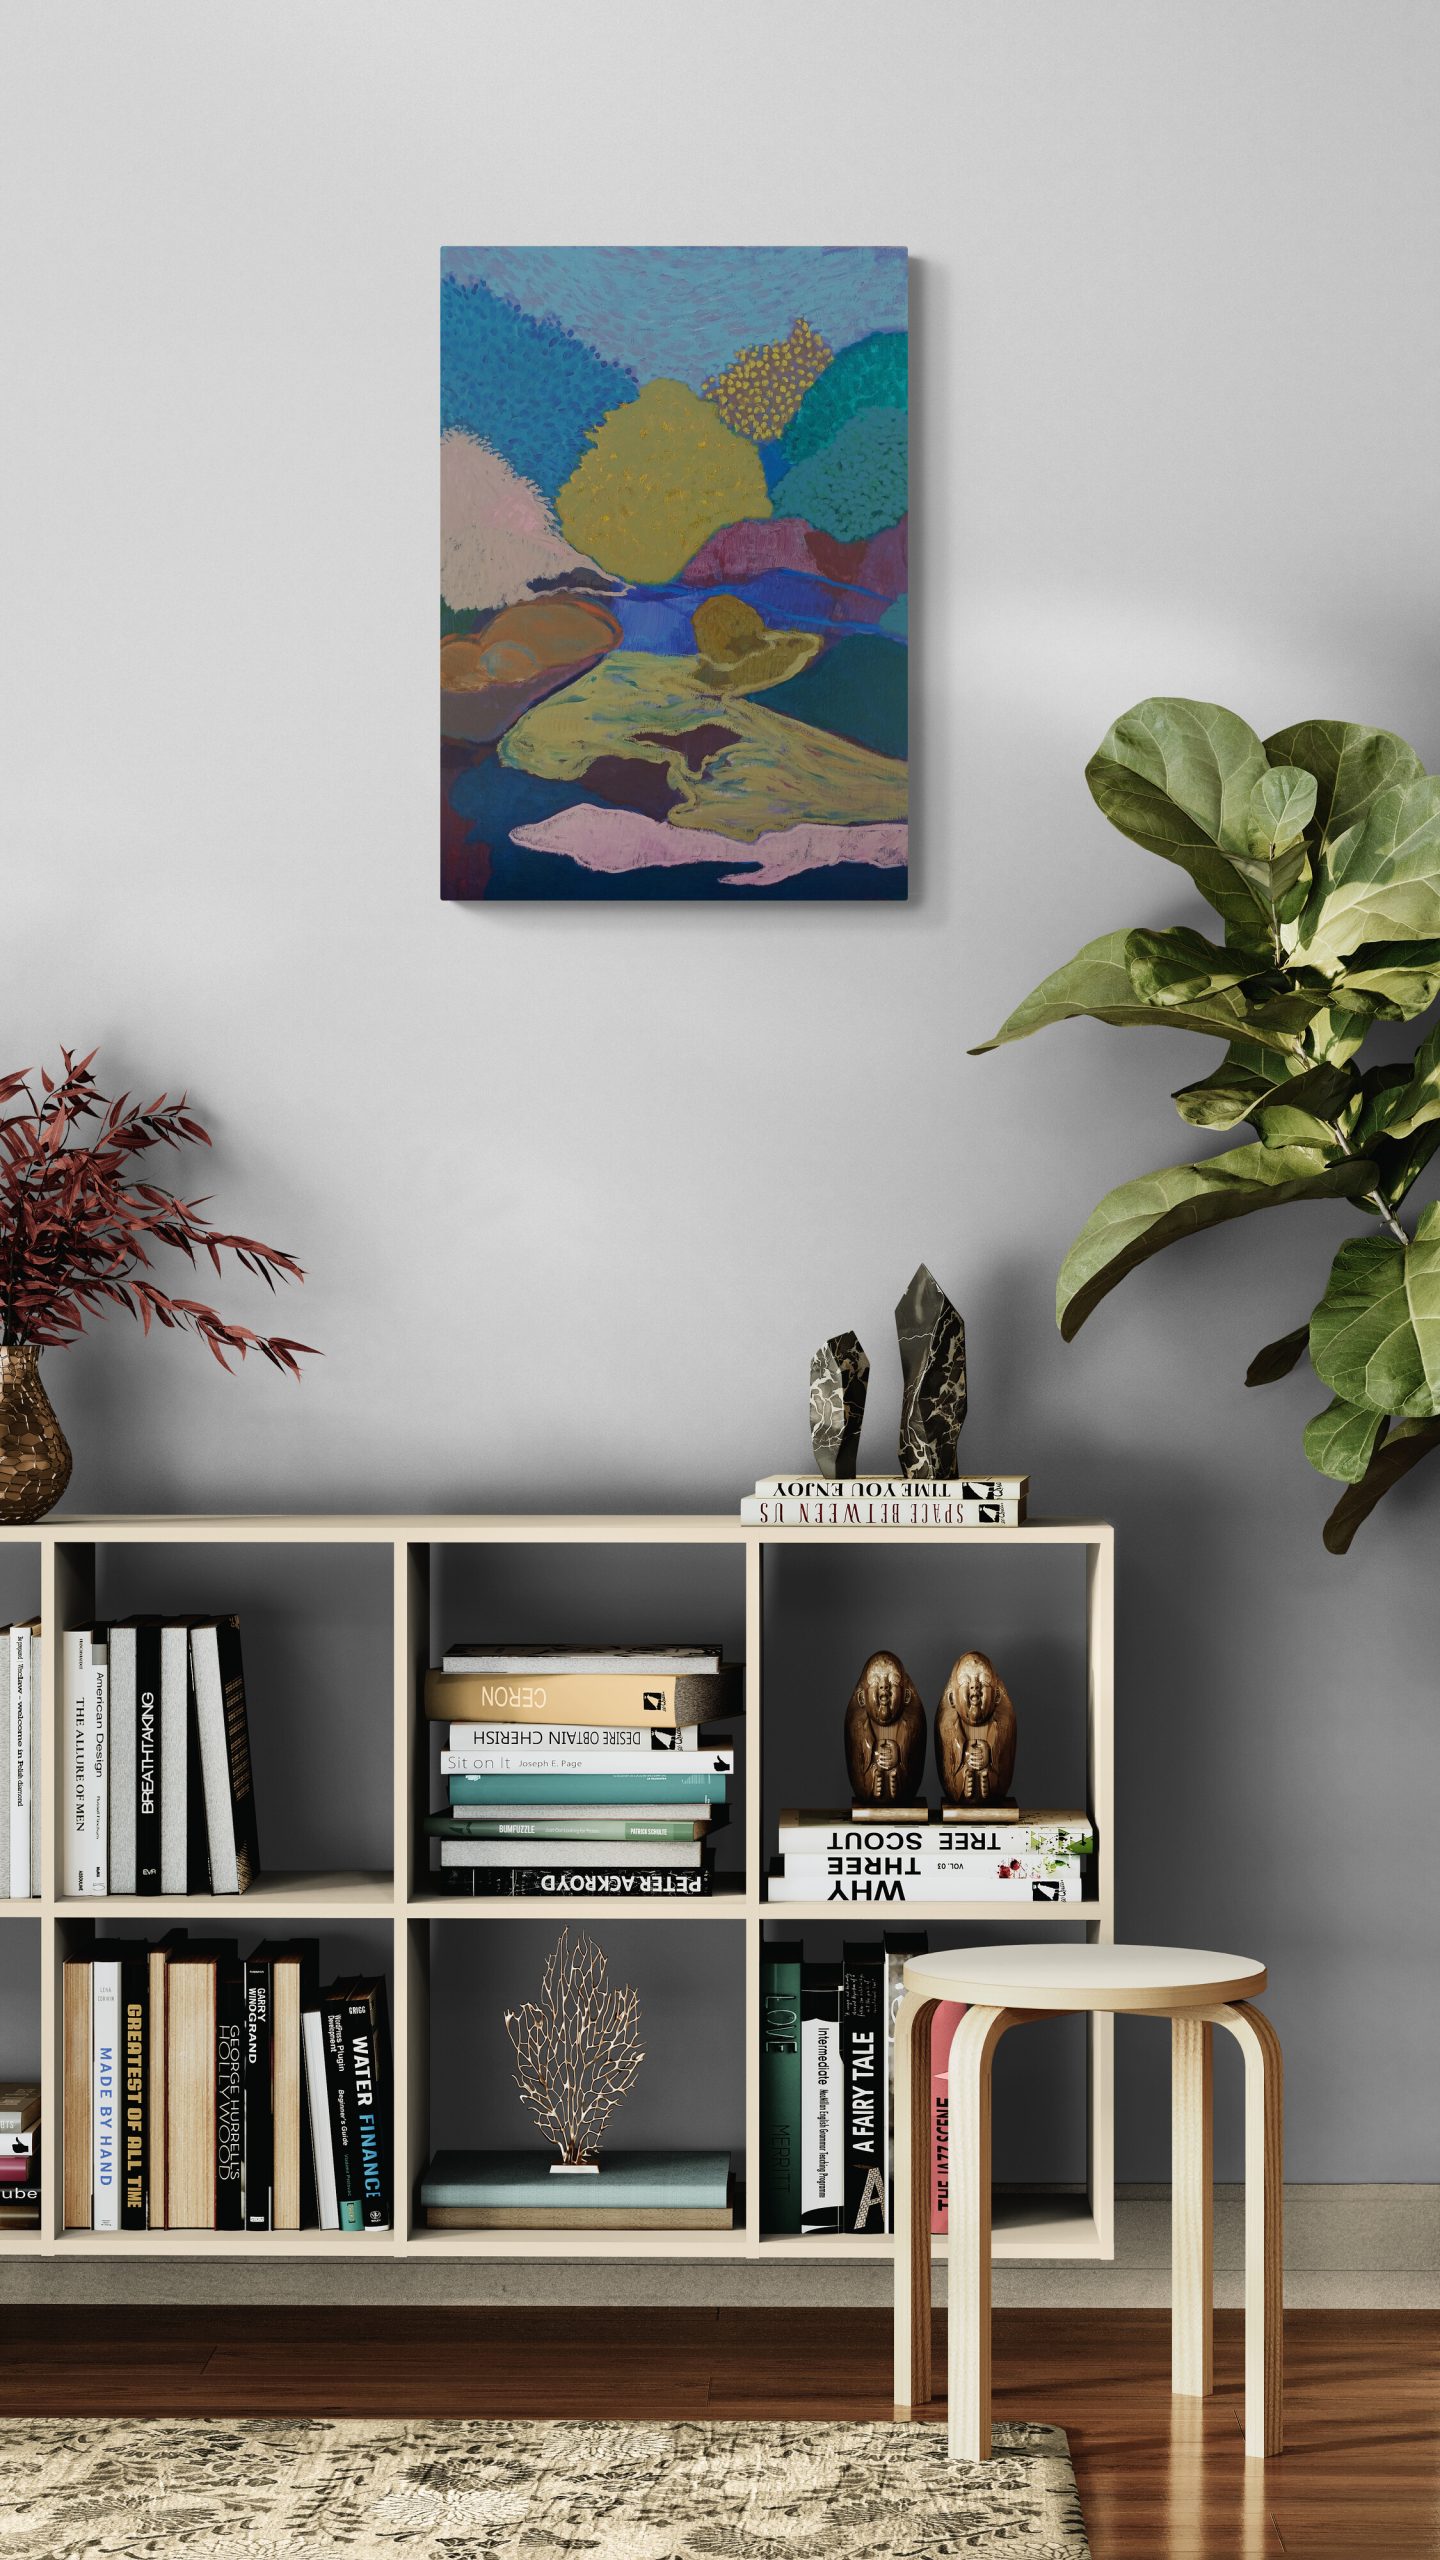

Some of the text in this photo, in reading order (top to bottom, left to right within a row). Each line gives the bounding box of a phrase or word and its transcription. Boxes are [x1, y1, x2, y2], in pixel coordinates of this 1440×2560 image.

[773, 1483, 950, 1497] TIME YOU ENJOY
[761, 1503, 963, 1523] SPACE BETWEEN US
[482, 1685, 547, 1708] CERON
[95, 1673, 104, 1777] American Design
[474, 1731, 640, 1745] DESIRE OBTAIN CHERISH
[18, 1749, 23, 1758] in
[76, 1698, 84, 1831] THE ALLURE OF MEN
[142, 1692, 154, 1813] BREATHTAKING
[448, 1756, 510, 1769] Sit on It
[520, 1760, 548, 1768] Joseph
[562, 1760, 582, 1768] Page
[498, 1824, 536, 1835] BUMFUZZLE
[827, 1833, 1001, 1850] TREE SCOUT
[828, 1857, 921, 1875] THREE
[541, 1875, 633, 1892] ACKROYD
[639, 1875, 702, 1893] PETER
[827, 1880, 905, 1901] WHY
[257, 1988, 265, 2022] GARRY
[349, 2006, 365, 2014] GRIGG
[249, 1988, 257, 2063] WINOGRAND
[328, 2015, 337, 2052] Development
[765, 1995, 798, 2053] LOVE
[334, 2014, 345, 2071] WordPress Plugin
[818, 2028, 829, 2085] Intermediate
[852, 2032, 874, 2081] TALE
[353, 2036, 372, 2105] WATER
[100, 2048, 112, 2185] MADE BY HAND
[128, 2004, 142, 2207] GREATEST OF ALL TIME
[219, 2026, 230, 2180] HOLLYWOOD
[230, 2025, 239, 2179] GEORGE HURRELL'S
[338, 2090, 346, 2124] Beginner's
[852, 2086, 874, 2135] FAIRY
[817, 2111, 828, 2128] English
[359, 2115, 380, 2198] FINANCE
[768, 2124, 791, 2193] MERRITT
[853, 2140, 874, 2152] A
